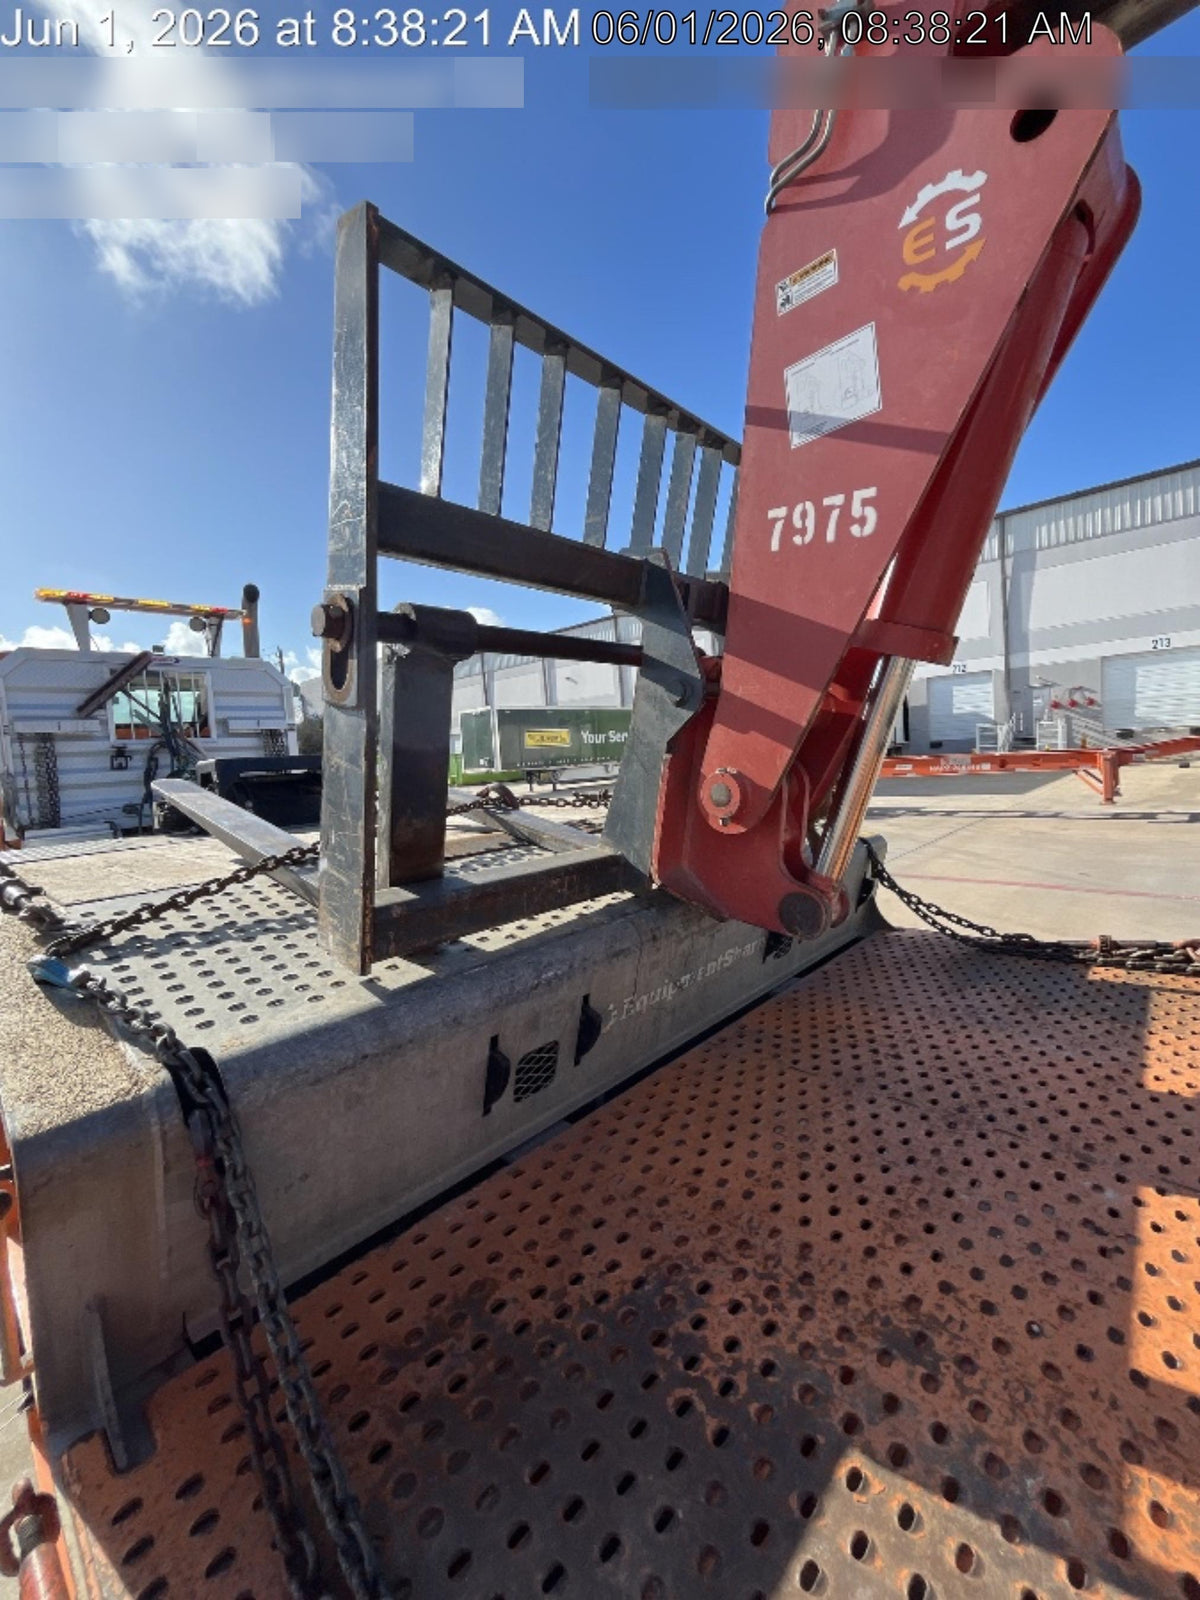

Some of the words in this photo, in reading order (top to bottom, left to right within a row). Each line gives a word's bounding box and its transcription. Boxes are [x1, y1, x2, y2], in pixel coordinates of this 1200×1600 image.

[767, 486, 878, 552] 7975
[1151, 637, 1171, 650] 213
[581, 730, 606, 744] Your
[608, 730, 629, 742] Ser
